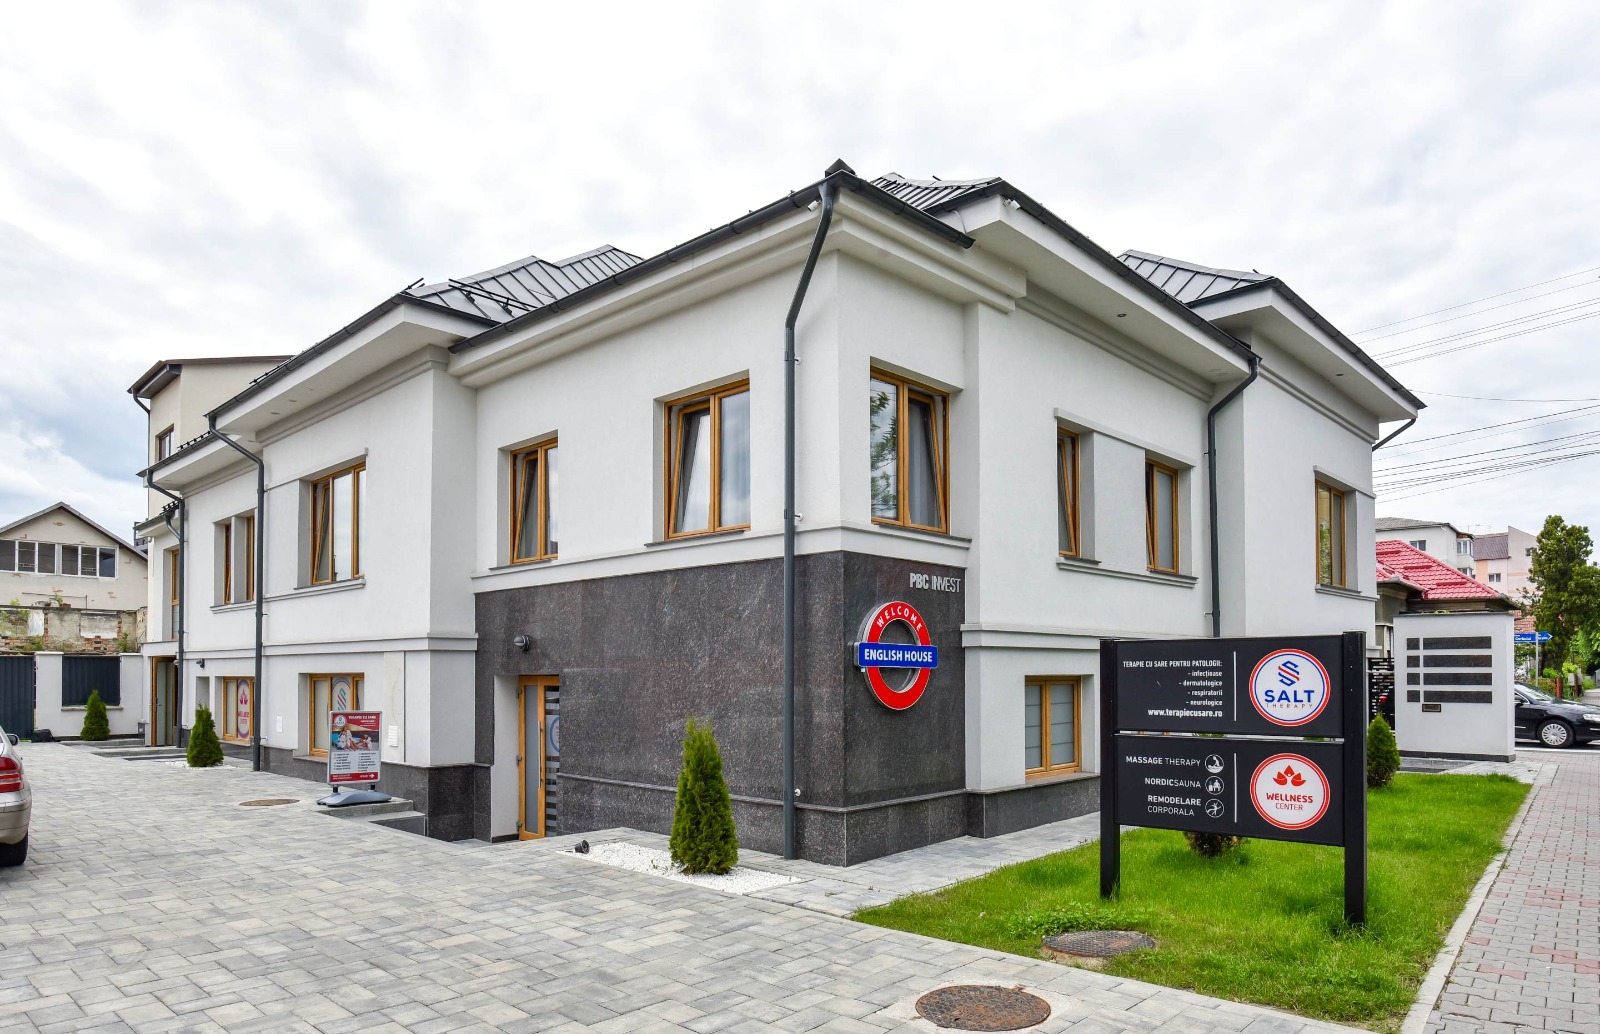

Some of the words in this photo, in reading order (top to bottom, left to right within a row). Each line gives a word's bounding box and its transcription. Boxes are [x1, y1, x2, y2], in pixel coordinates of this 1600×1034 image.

[909, 572, 930, 590] PBC
[931, 575, 961, 592] INVEST
[876, 605, 922, 631] WELCOME
[864, 648, 903, 661] ENGLISH
[904, 650, 933, 662] HOUSE
[1123, 660, 1145, 668] TERAPIE
[1145, 660, 1153, 668] CU
[1153, 660, 1168, 668] SARE
[1191, 689, 1223, 697] respiratorii
[1264, 689, 1315, 703] SALT
[1190, 699, 1223, 707] neurologice
[1147, 708, 1223, 718] www.terapiecusare.ro
[1125, 756, 1163, 765] MASSAGE
[1164, 757, 1201, 767] THERAPY
[1144, 777, 1202, 788] NORDICSAUNA
[1147, 795, 1202, 806] REMODELARE
[1266, 792, 1314, 803] WELLNESS
[1147, 805, 1195, 816] CORPORALA
[1275, 802, 1304, 811] CENTER
